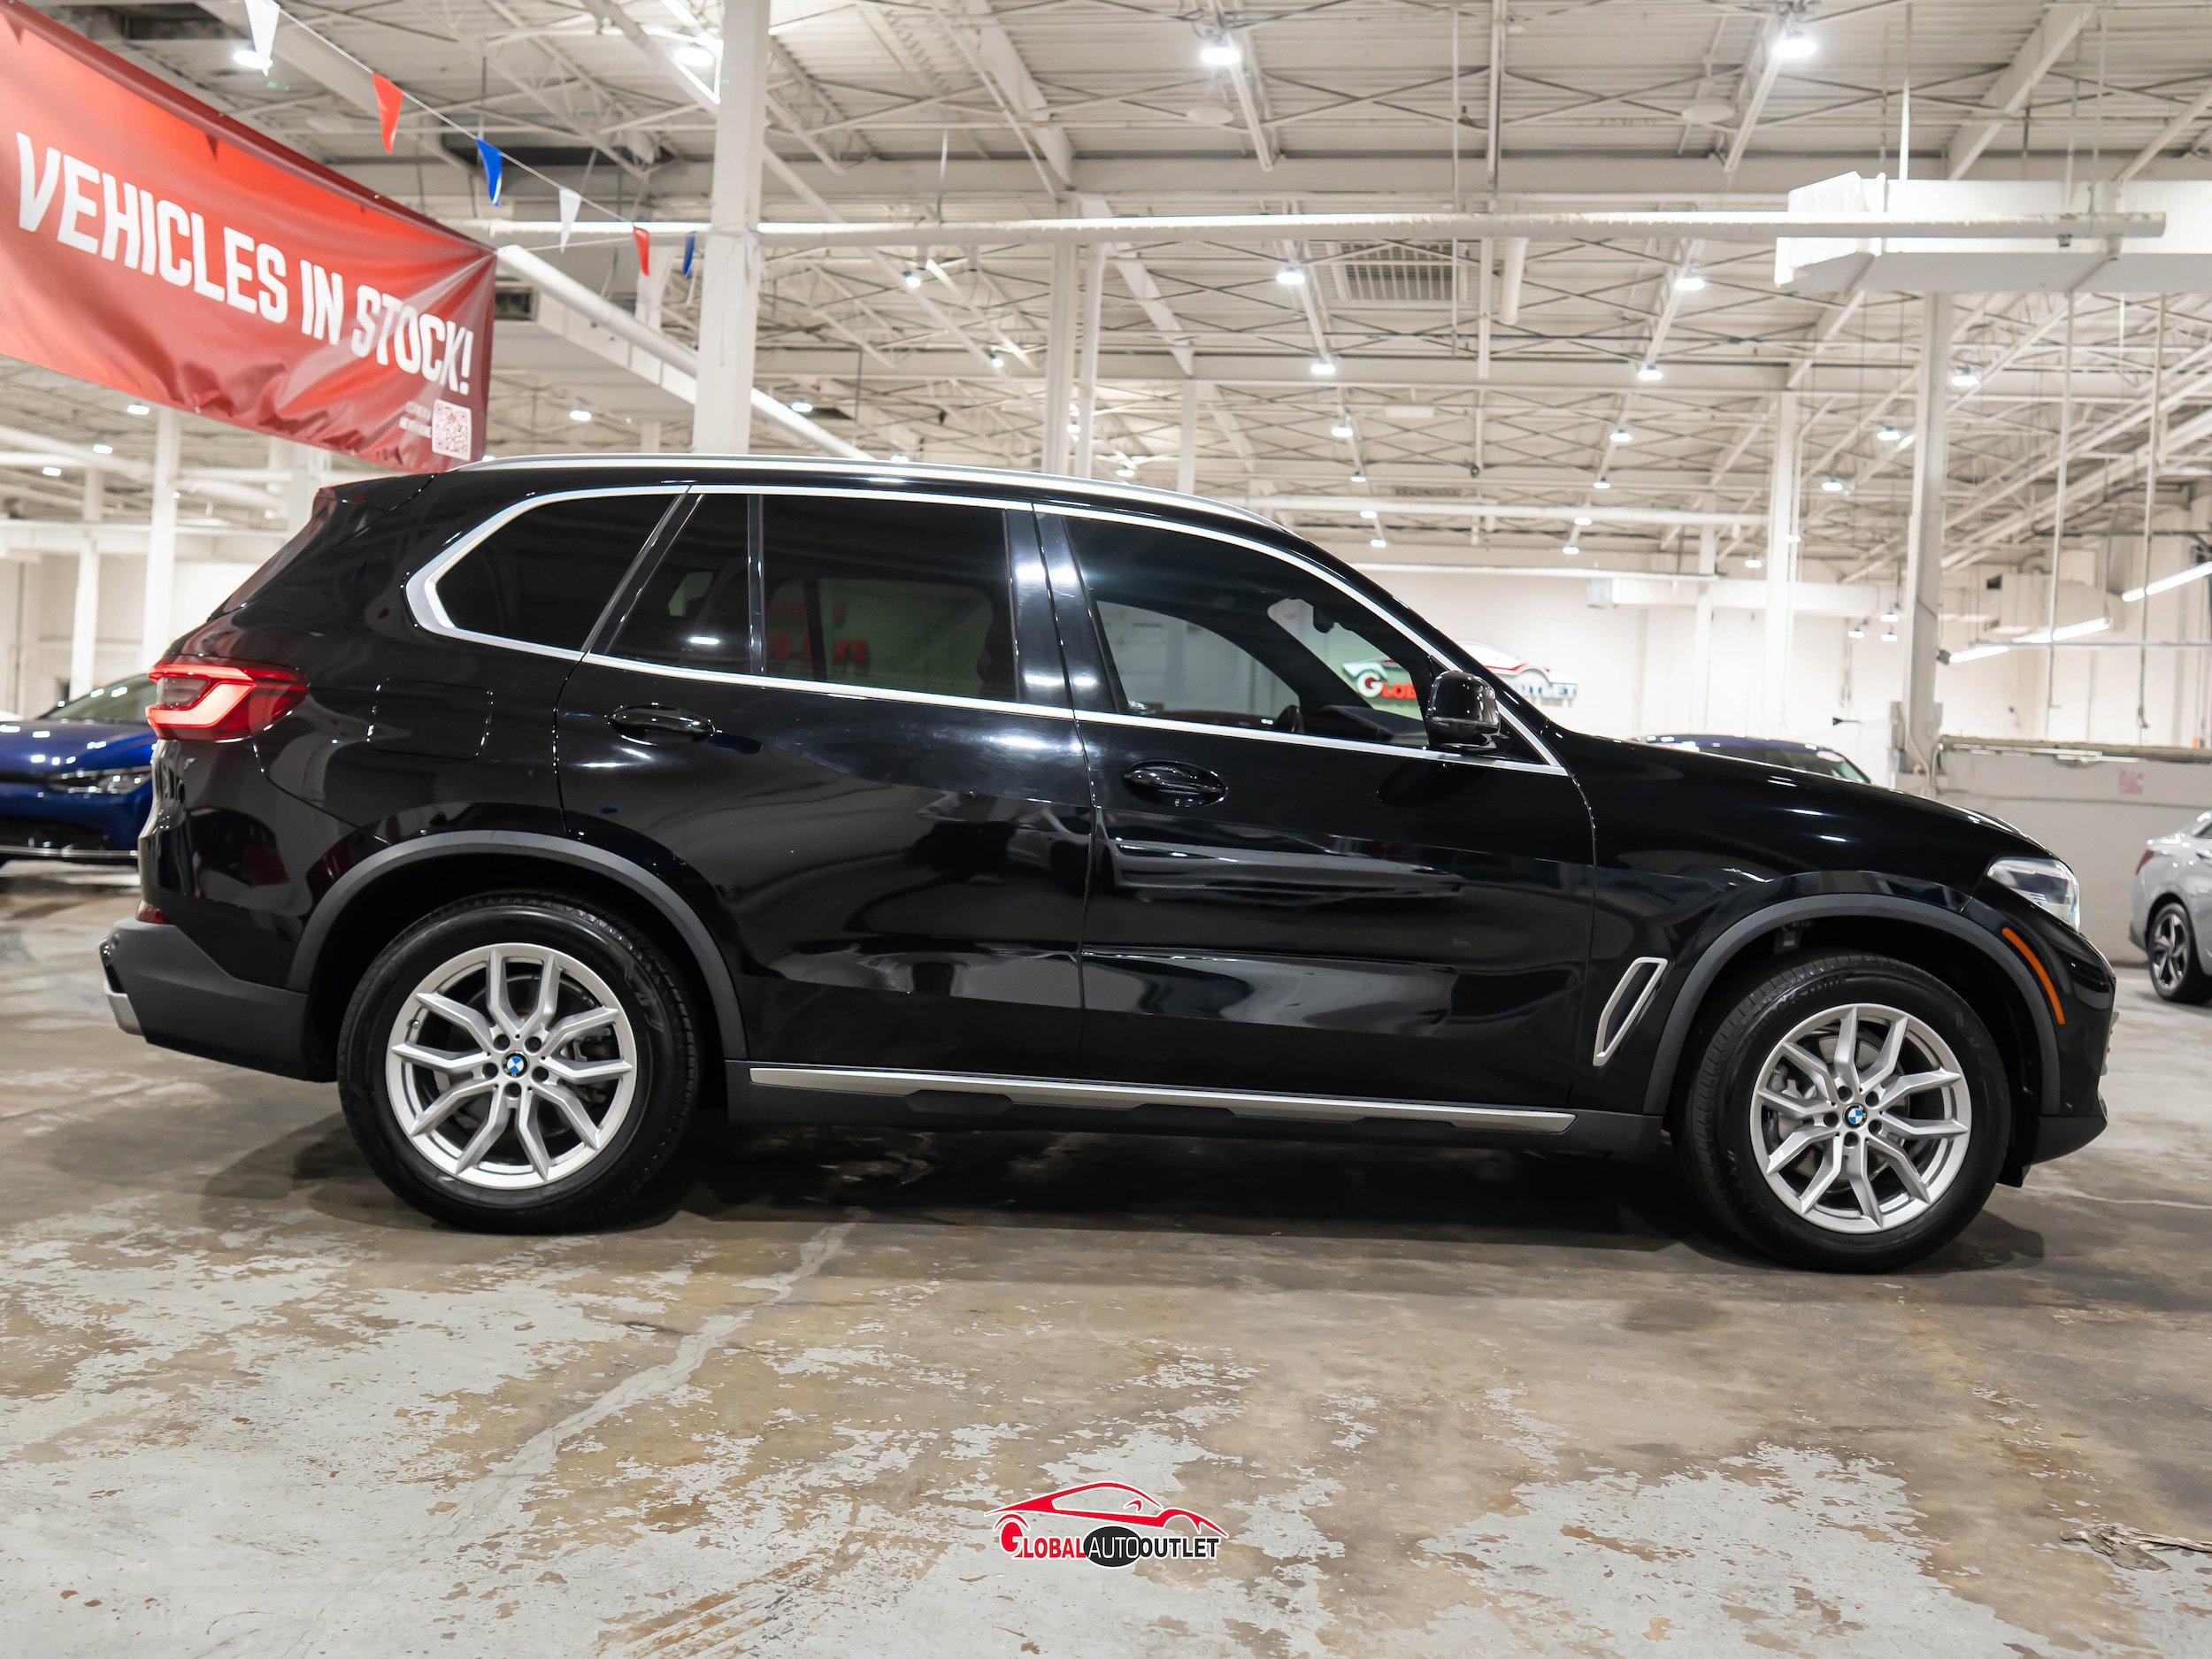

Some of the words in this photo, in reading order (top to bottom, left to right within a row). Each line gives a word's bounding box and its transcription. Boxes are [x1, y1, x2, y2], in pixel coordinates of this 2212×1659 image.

[15, 131, 288, 324] VEHICLES
[300, 258, 344, 346] IN
[350, 284, 474, 396] STOCK!
